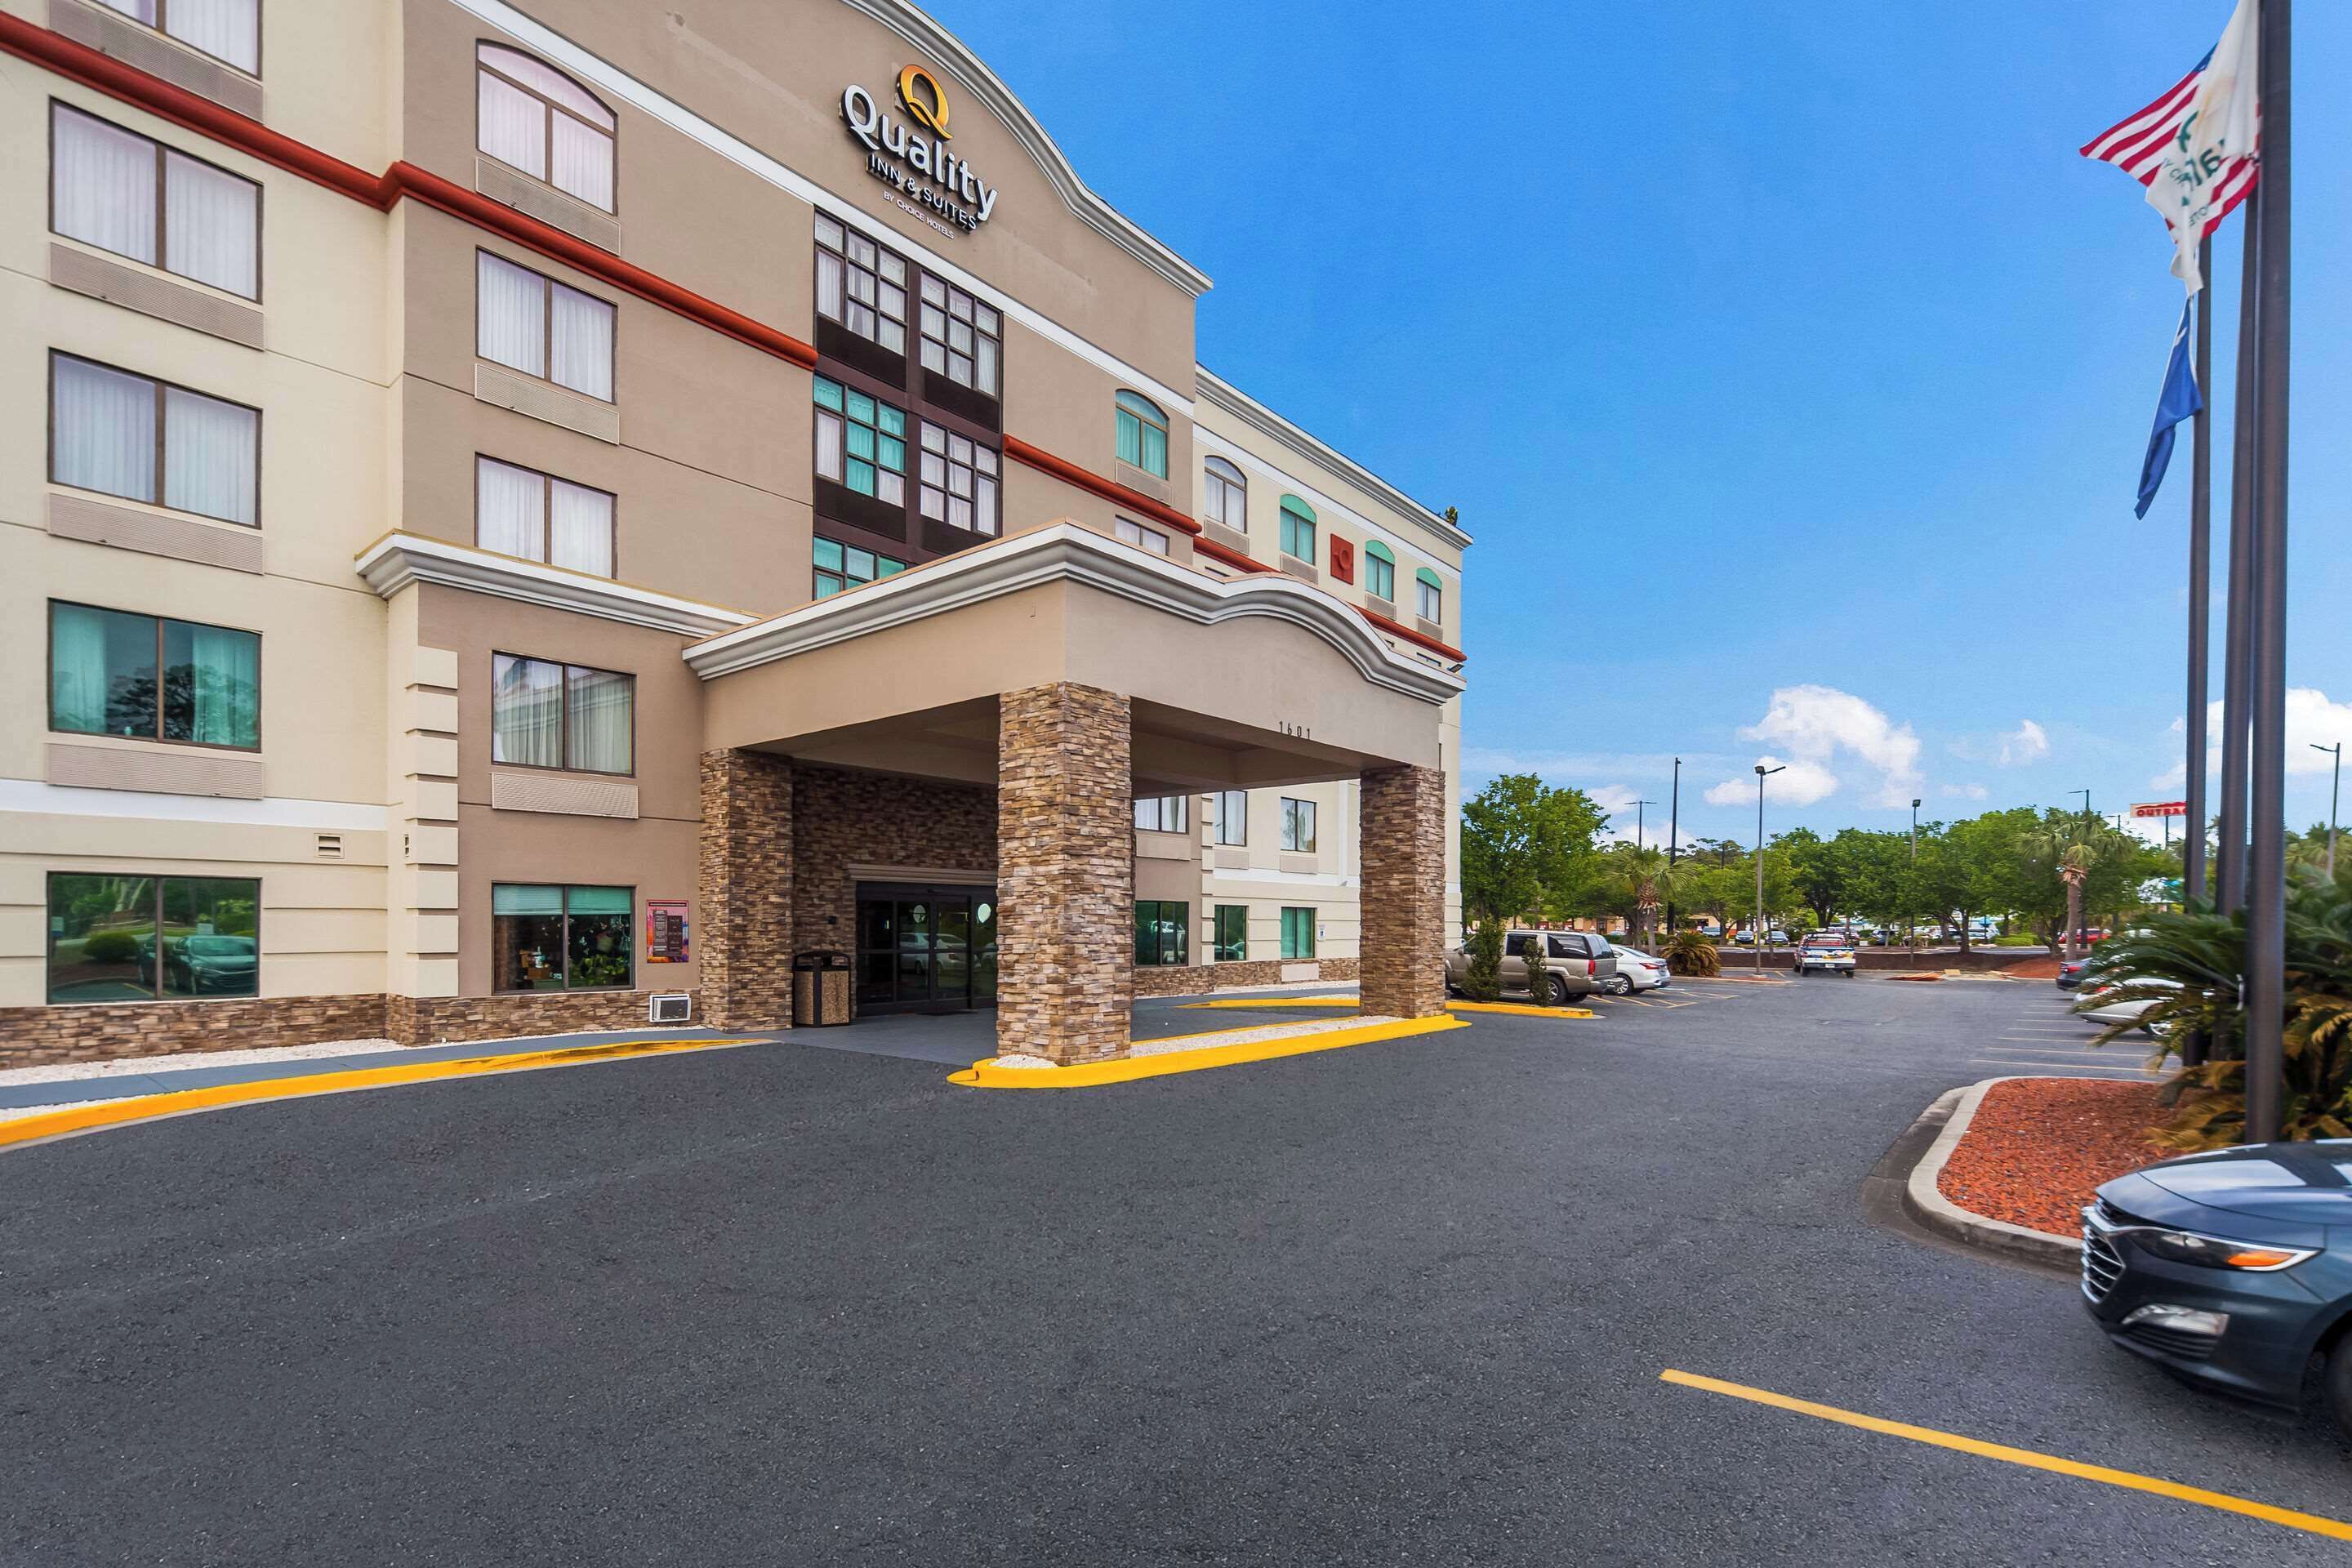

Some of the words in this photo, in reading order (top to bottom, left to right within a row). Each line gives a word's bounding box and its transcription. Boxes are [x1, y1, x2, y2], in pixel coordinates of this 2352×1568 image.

[843, 84, 998, 221] Quality
[869, 153, 902, 185] INN
[905, 176, 915, 194] &
[920, 186, 977, 232] SUITES
[883, 190, 895, 203] BY
[897, 199, 926, 223] CHOICE
[926, 216, 955, 240] HOTELS
[1279, 721, 1310, 740] 1601
